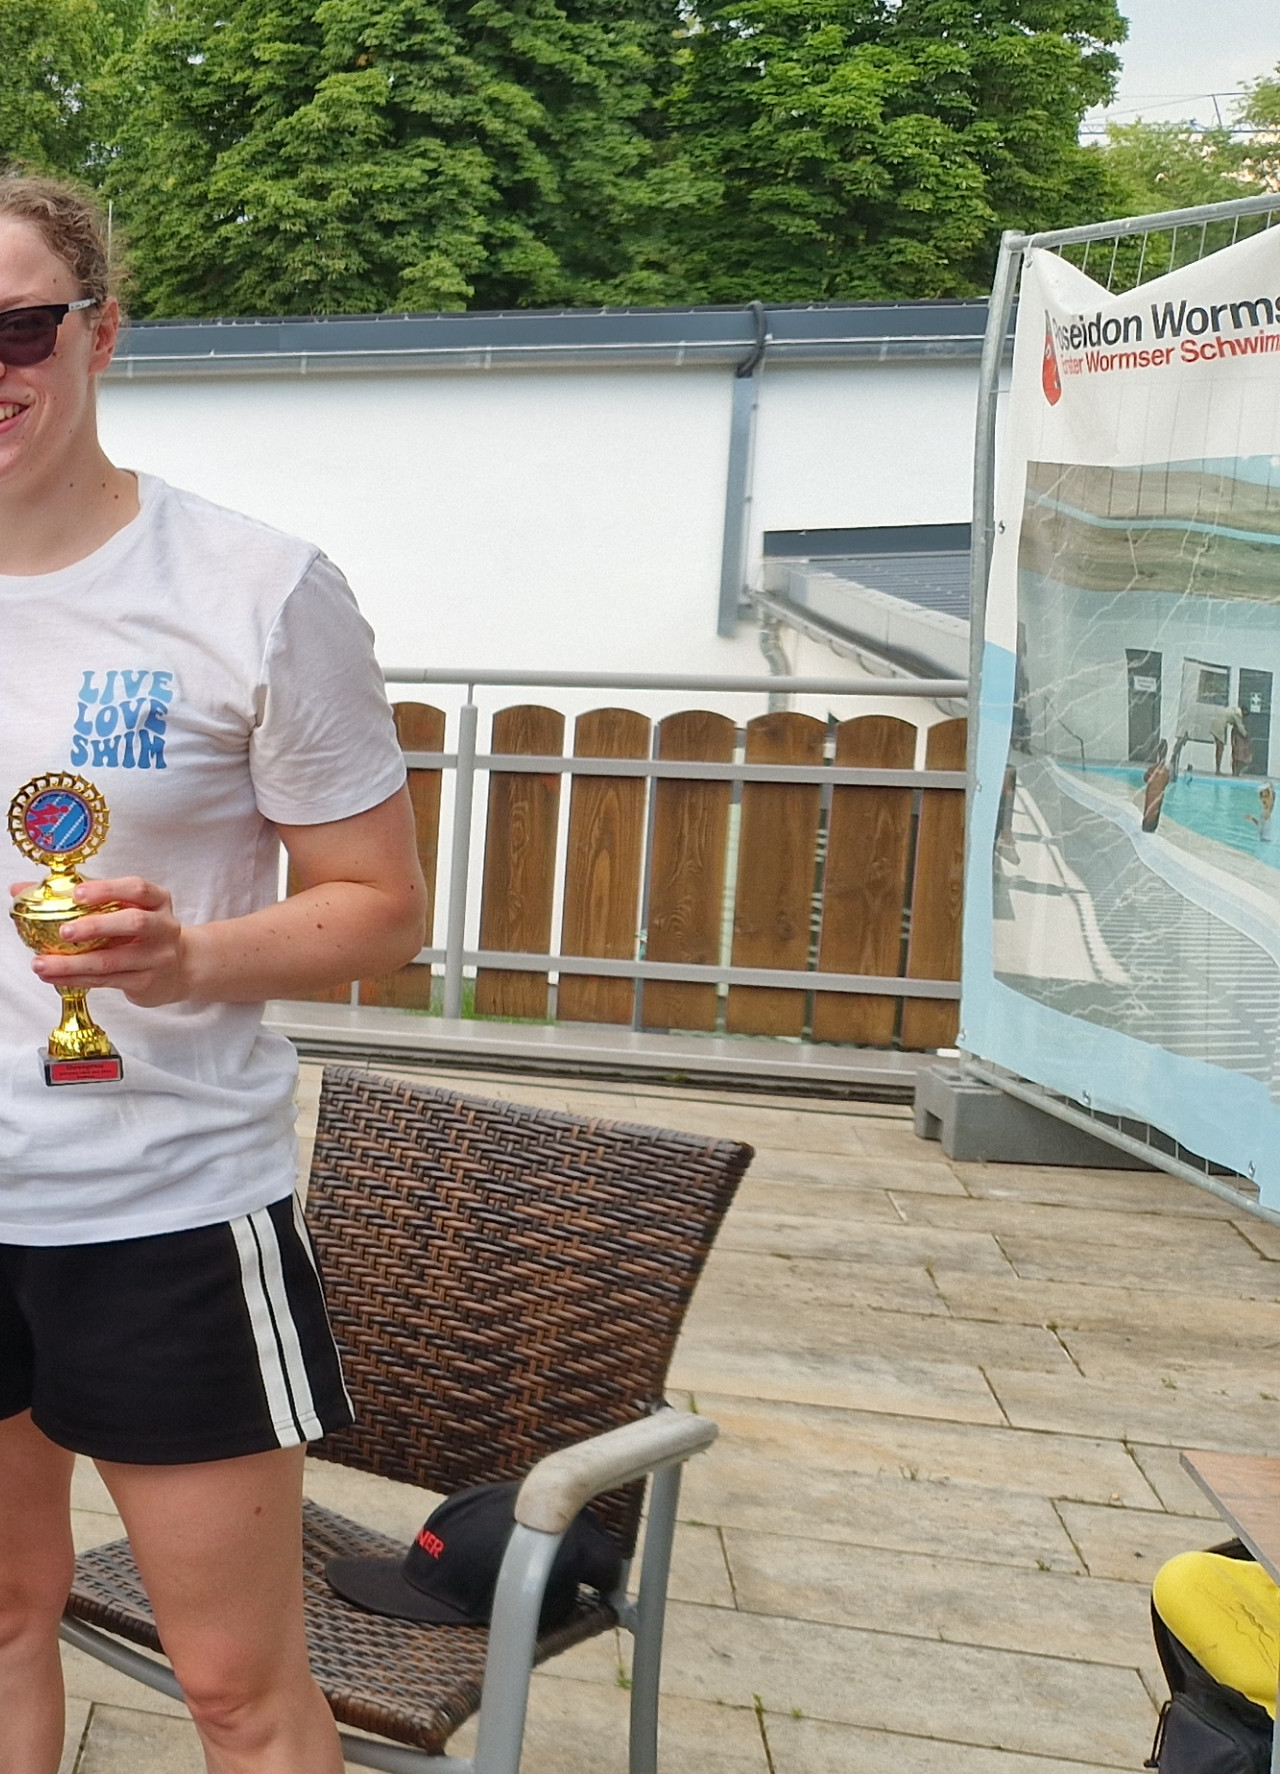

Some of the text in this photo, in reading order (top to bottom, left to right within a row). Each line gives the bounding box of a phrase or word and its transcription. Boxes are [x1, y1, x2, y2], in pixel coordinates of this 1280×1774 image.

[1151, 297, 1280, 339] Worm
[1086, 346, 1175, 373] Wormser
[1181, 330, 1280, 363] Schwim
[78, 669, 173, 705] LIVE
[73, 698, 168, 737] LOVE
[70, 729, 168, 769] SWIM
[416, 1528, 445, 1560] NER
